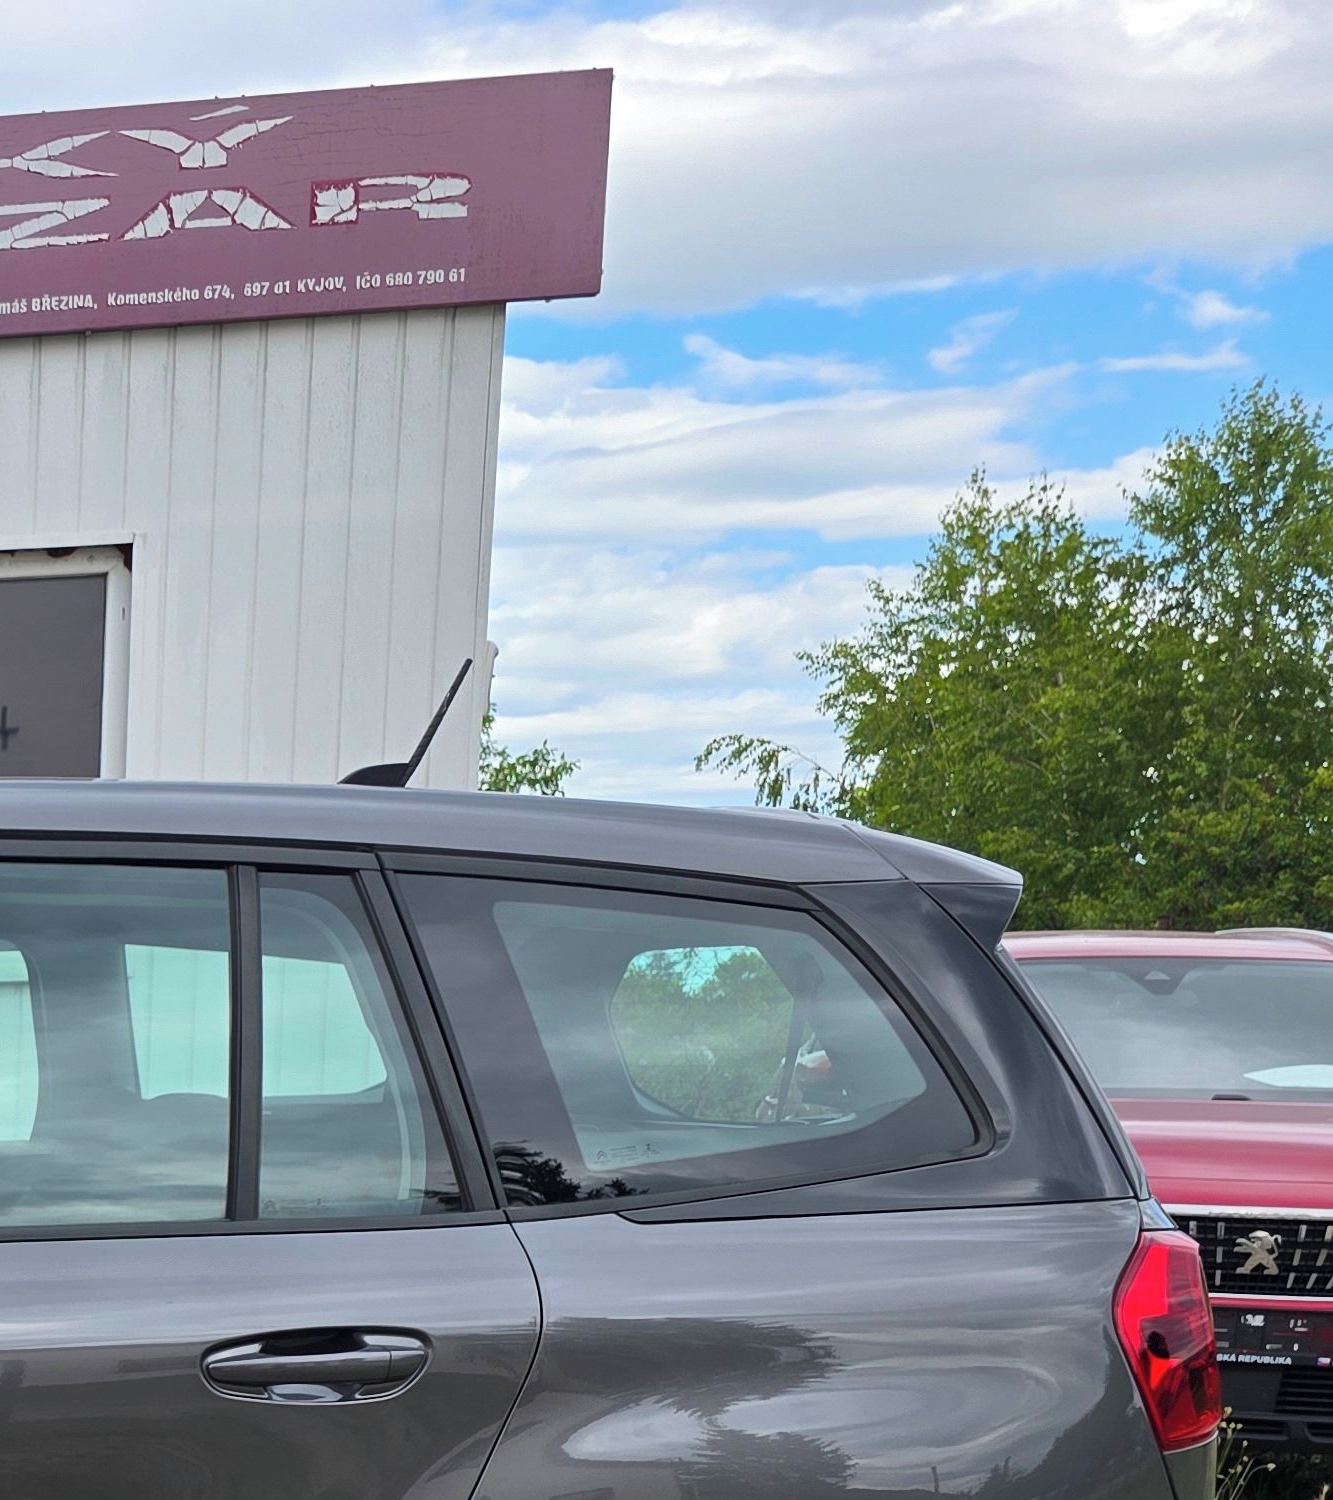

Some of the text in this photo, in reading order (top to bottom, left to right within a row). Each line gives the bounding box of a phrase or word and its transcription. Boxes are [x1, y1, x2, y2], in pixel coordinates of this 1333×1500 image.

[31, 294, 98, 311] BŘEZINA,
[107, 287, 200, 306] Komenského
[204, 284, 235, 300] 674,
[243, 281, 270, 297] 697
[273, 280, 290, 295] 01
[297, 276, 347, 293] KYJOV,
[356, 271, 381, 290] IČO
[385, 271, 413, 287] 680
[417, 269, 445, 285] 790
[448, 268, 466, 283] 61
